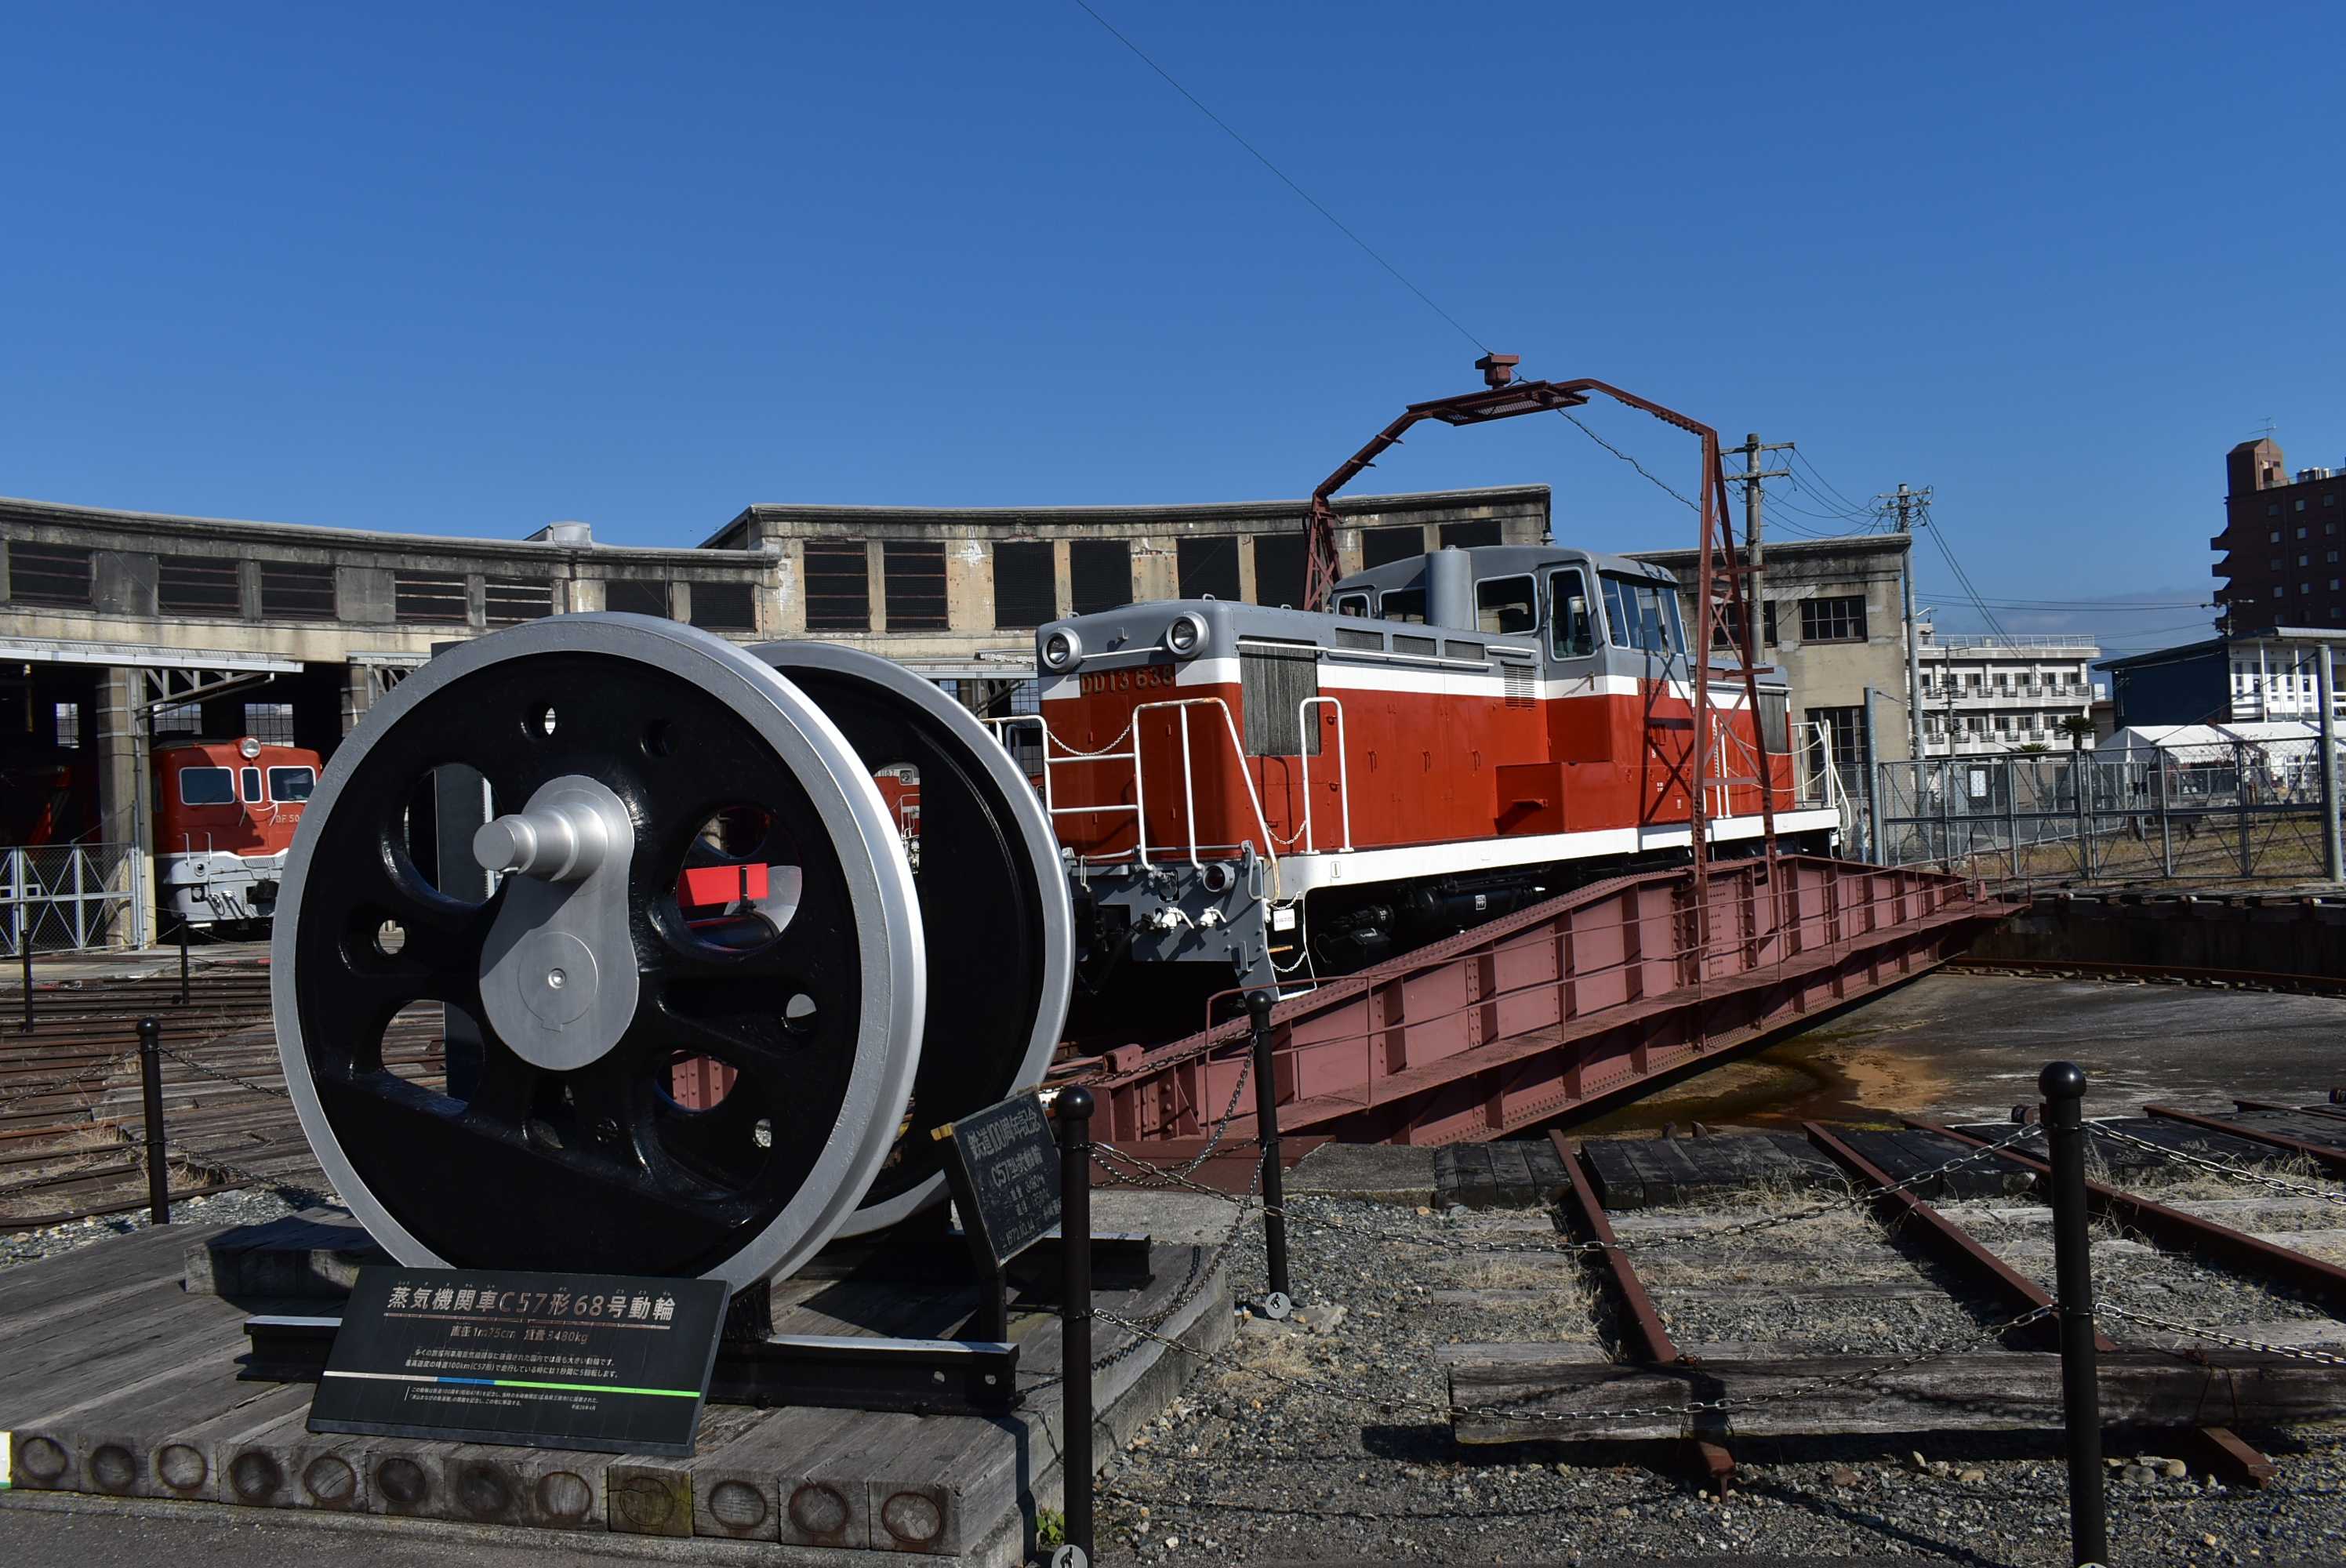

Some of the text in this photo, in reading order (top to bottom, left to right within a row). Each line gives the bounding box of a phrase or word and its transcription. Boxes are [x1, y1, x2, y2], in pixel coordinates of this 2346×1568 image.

[1136, 664, 1175, 688] 638
[276, 814, 300, 823] DF 50
[387, 1286, 676, 1321] 蒸気機関車C57形68号動輪
